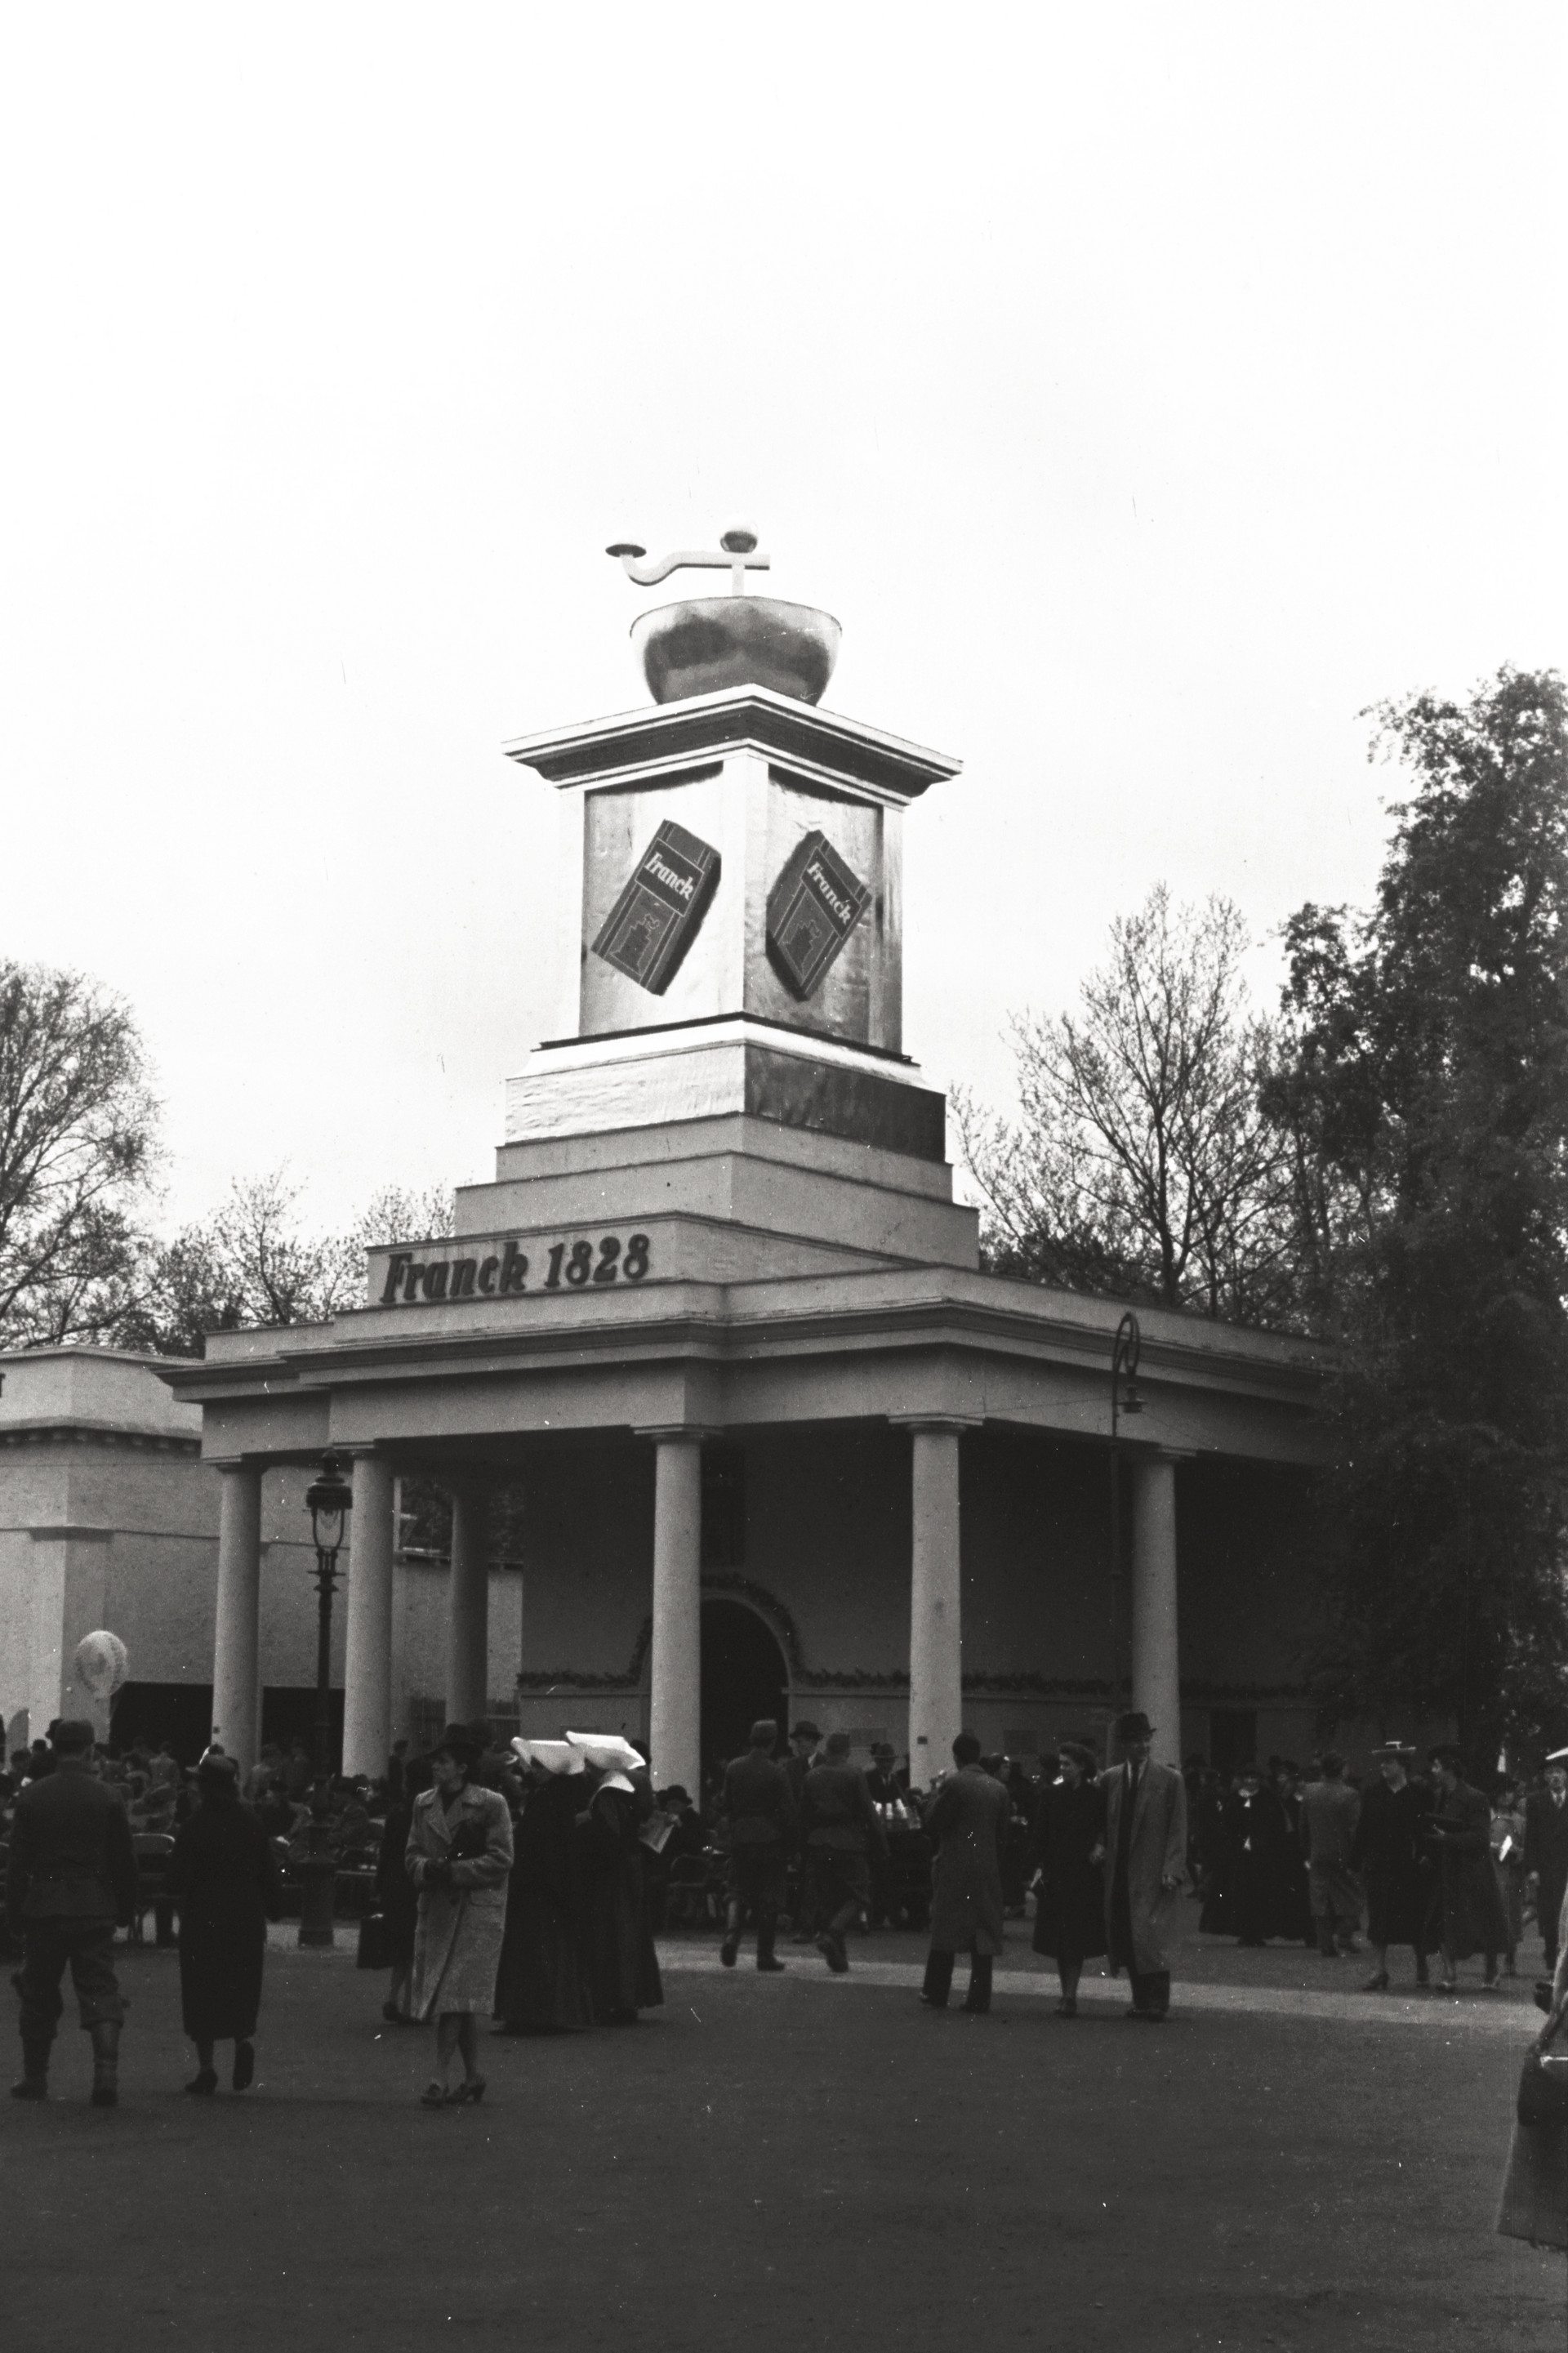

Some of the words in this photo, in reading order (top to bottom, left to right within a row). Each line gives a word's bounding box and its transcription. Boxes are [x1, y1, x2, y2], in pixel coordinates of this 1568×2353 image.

[644, 852, 694, 900] Franck
[806, 861, 852, 925] Franck
[380, 1241, 528, 1304] Franck
[545, 1233, 649, 1288] 1828
